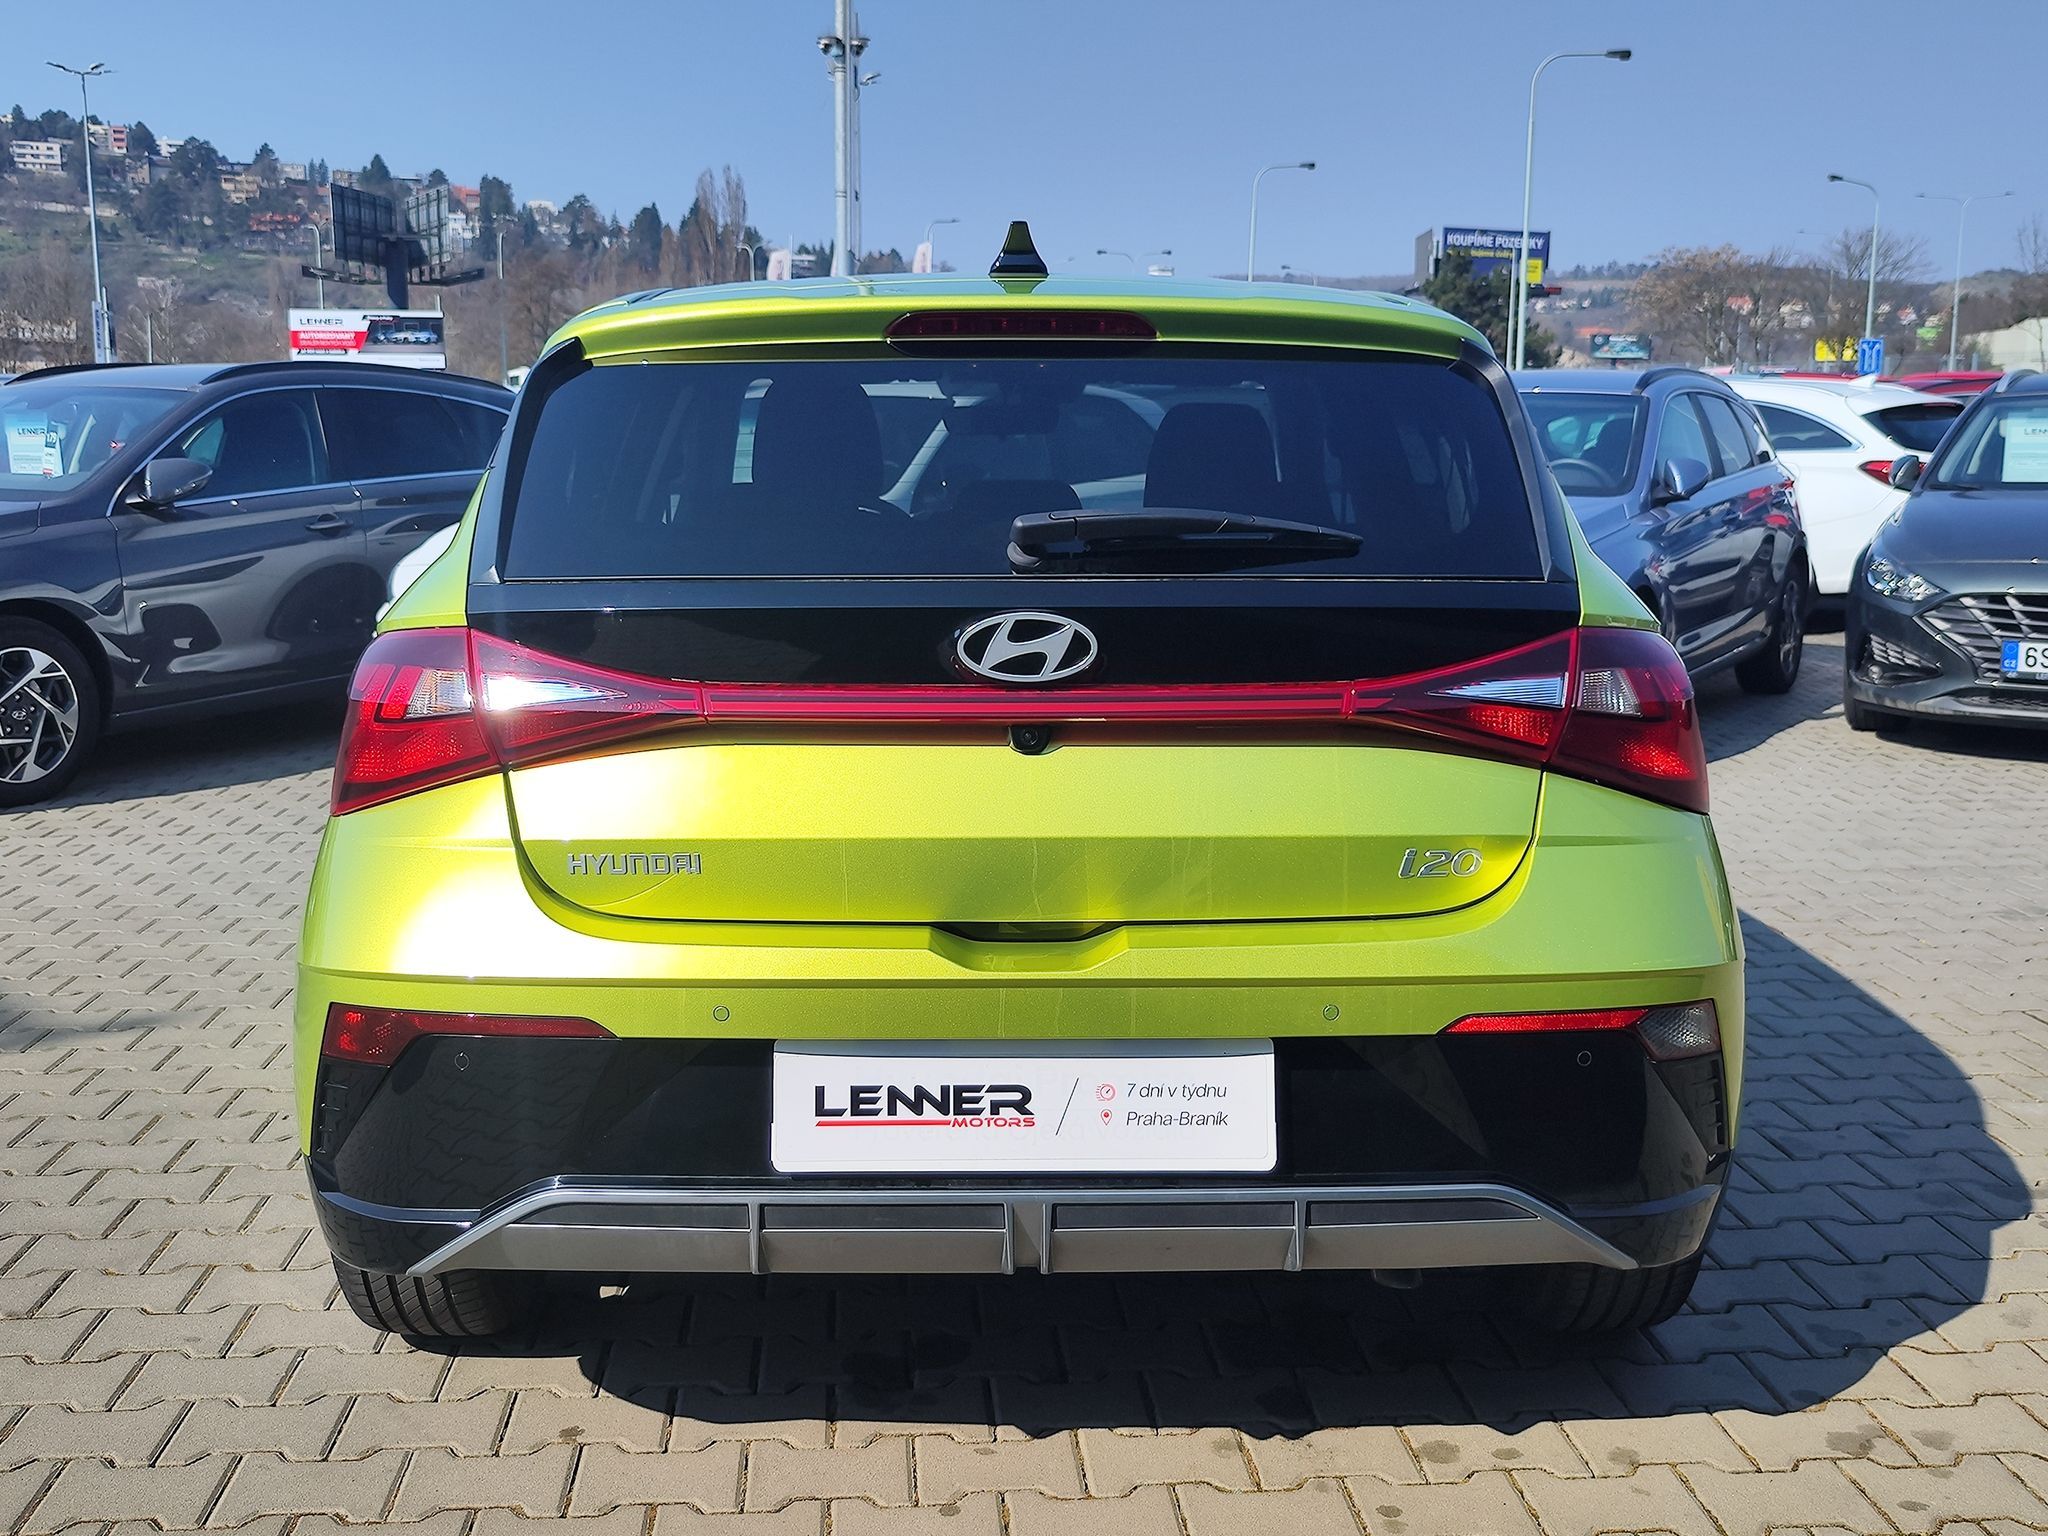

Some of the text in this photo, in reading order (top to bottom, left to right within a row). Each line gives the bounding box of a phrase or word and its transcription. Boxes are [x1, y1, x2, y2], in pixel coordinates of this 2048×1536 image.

[1447, 231, 1544, 250] KOUPÍME POZEKY
[299, 318, 343, 326] LENNER
[17, 428, 46, 436] LENNER
[567, 853, 702, 875] HYUNDAI
[1398, 848, 1483, 878] i20
[815, 1083, 1035, 1117] LENNER
[1127, 1083, 1228, 1101] 7 dní v týdnu
[951, 1116, 1036, 1128] MOTORS
[1126, 1110, 1229, 1126] Praha-Braník
